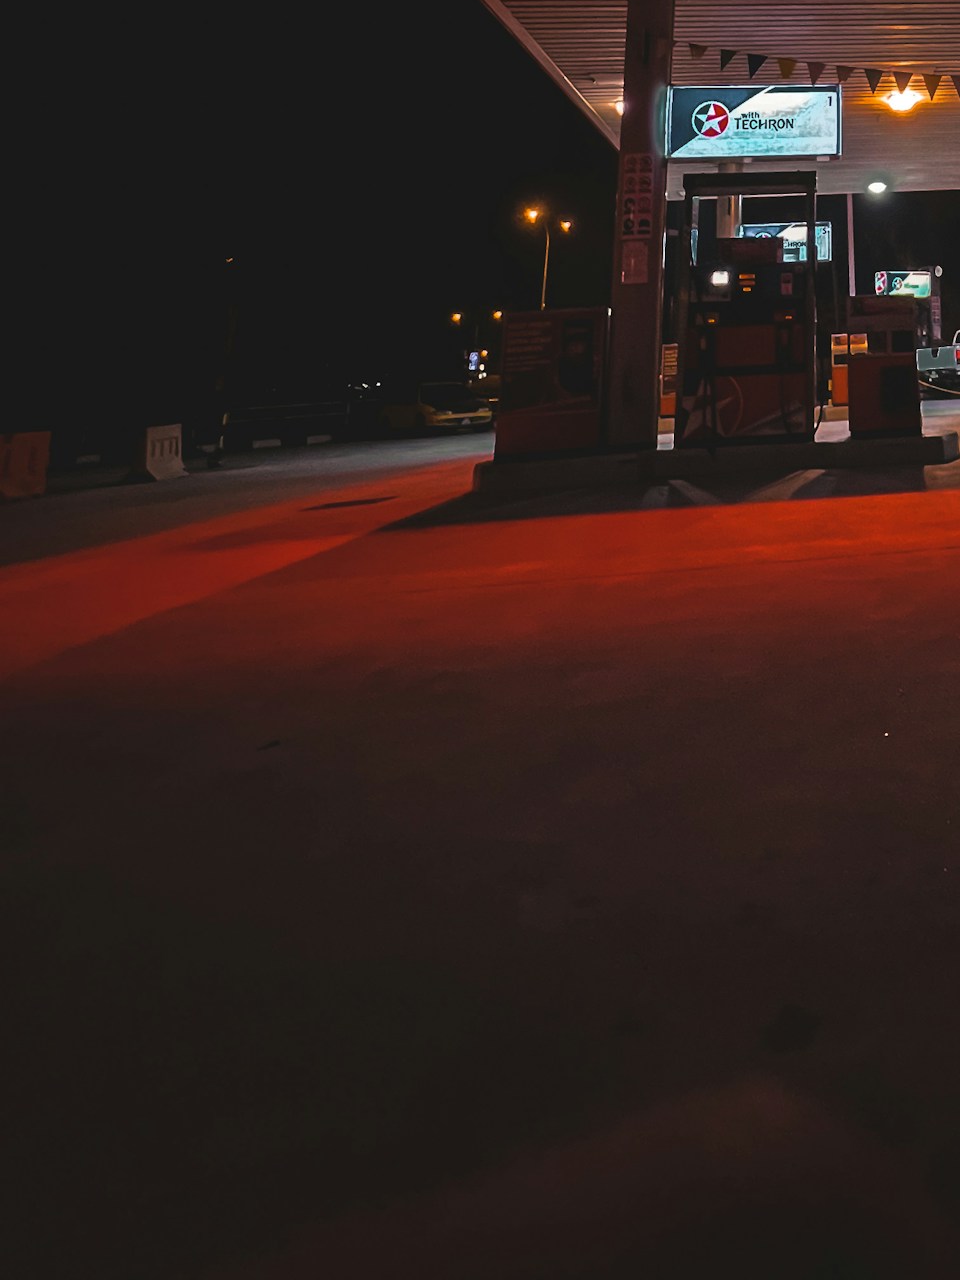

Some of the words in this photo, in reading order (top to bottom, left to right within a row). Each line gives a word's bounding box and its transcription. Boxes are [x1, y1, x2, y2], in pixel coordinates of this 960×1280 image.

[828, 96, 832, 106] 1
[741, 111, 760, 119] with
[734, 117, 794, 131] TECHRON
